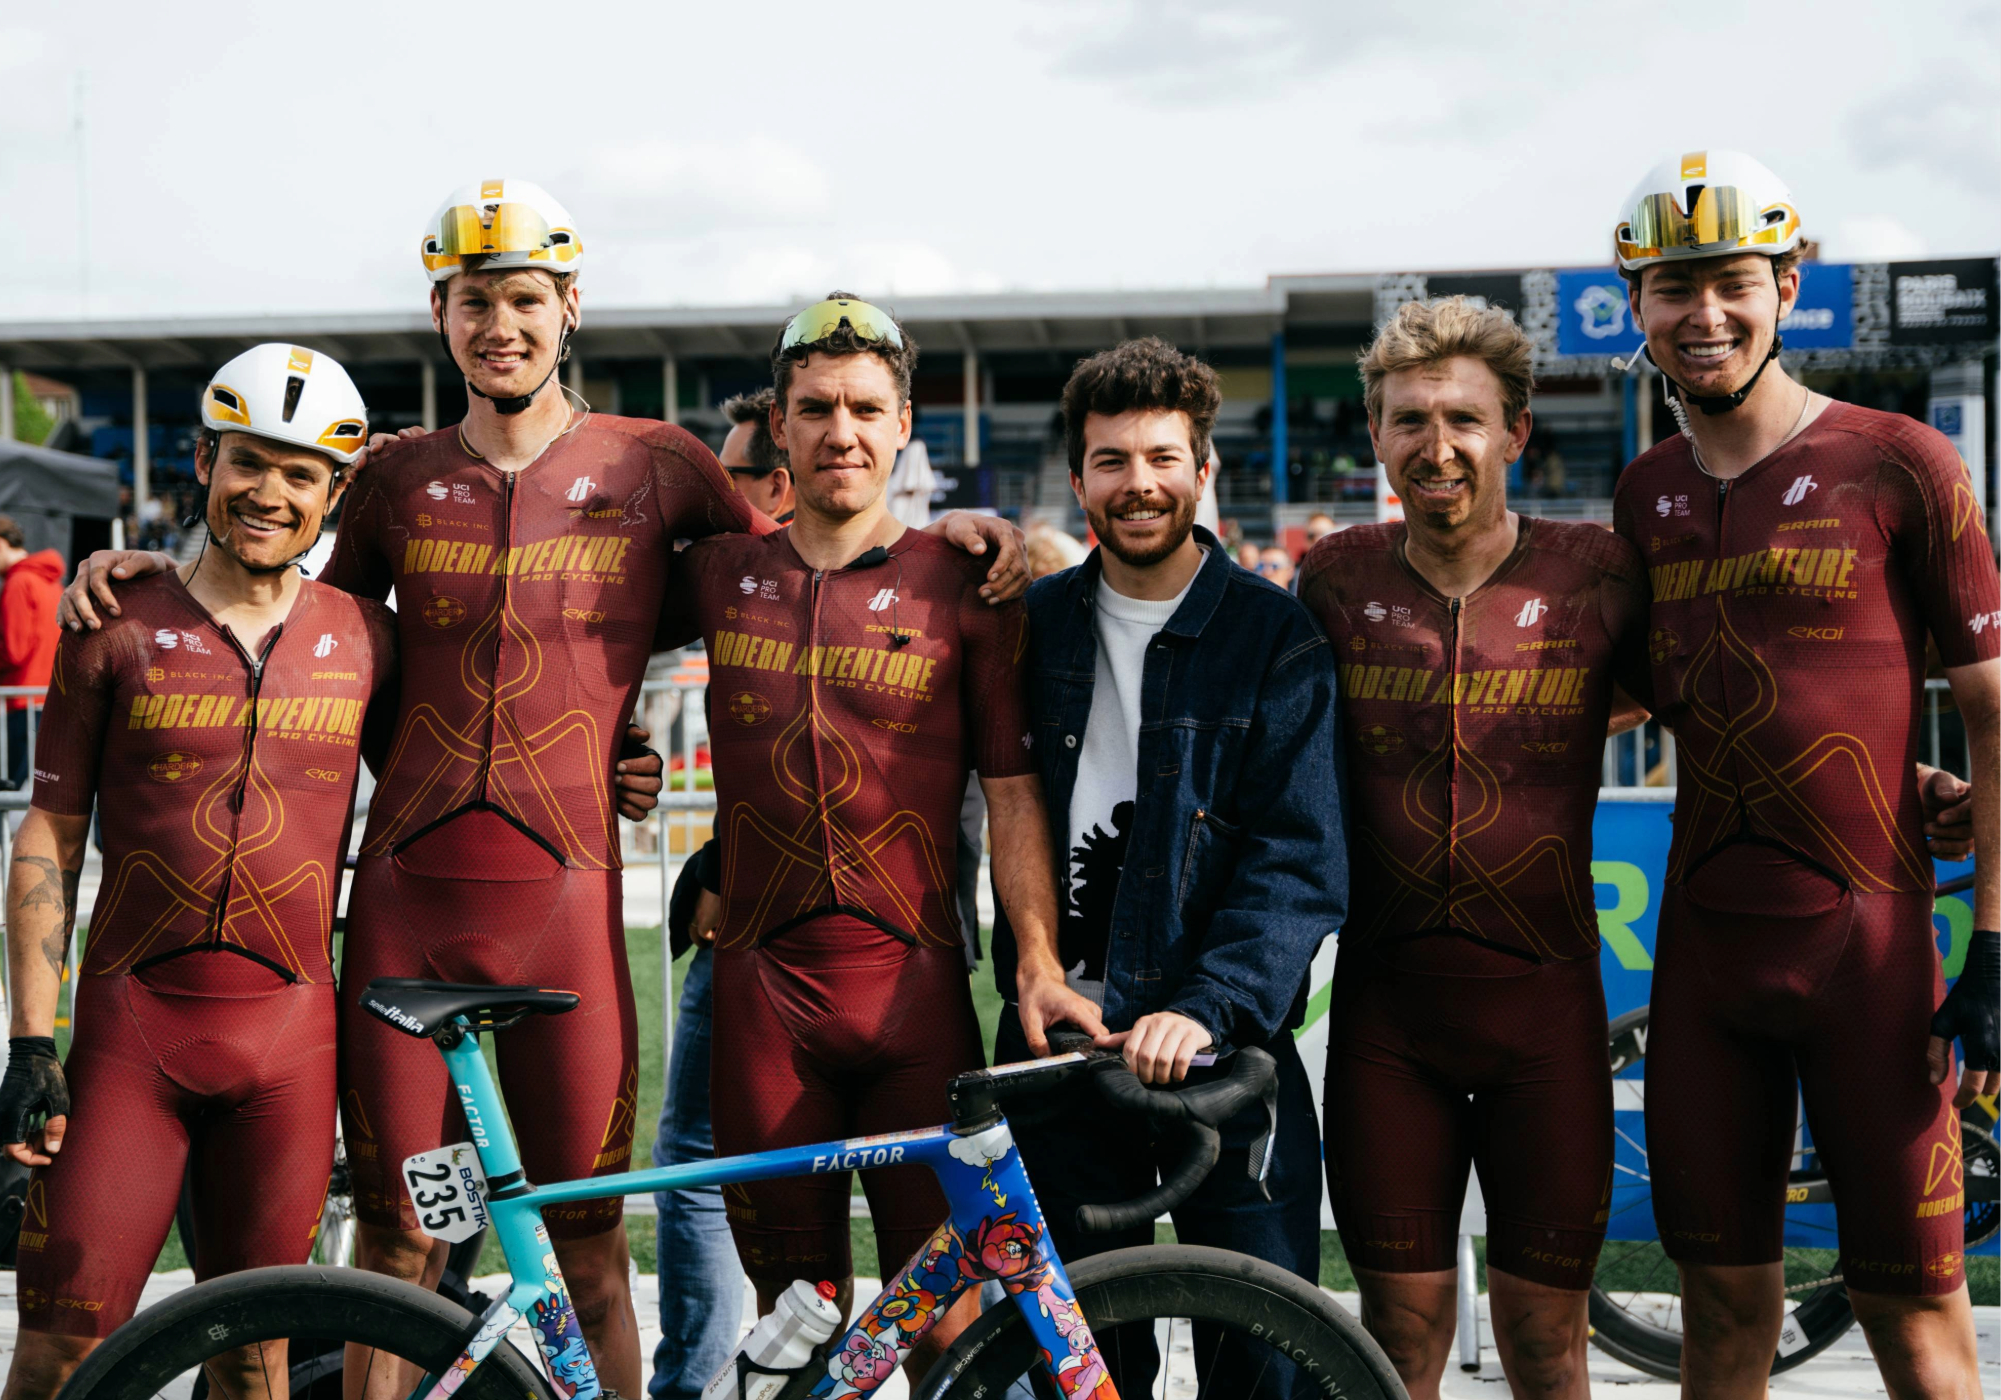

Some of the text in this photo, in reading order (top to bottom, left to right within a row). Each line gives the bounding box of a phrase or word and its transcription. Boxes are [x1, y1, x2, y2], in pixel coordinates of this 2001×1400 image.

[453, 483, 470, 491] UCI
[453, 490, 470, 498] PRO
[453, 496, 475, 505] TEAM
[1674, 495, 1688, 503] UCI
[1674, 502, 1688, 510] PRO
[1674, 509, 1691, 517] TEAM
[437, 518, 490, 531] BLACK INC
[1776, 518, 1840, 532] SRAM
[404, 535, 632, 576] MODERN ADVENTURE
[1703, 548, 1858, 595] ADVENTURE
[520, 572, 625, 585] PRO CYCLING
[762, 579, 778, 587] UCI
[760, 585, 777, 594] PRO
[1735, 587, 1858, 599] PRO CYCLING
[759, 591, 780, 602] TEAM
[1391, 605, 1411, 615] UCI
[740, 612, 790, 628] BLACK INC
[1391, 612, 1411, 623] PRO
[864, 624, 922, 638] SRAM
[1391, 619, 1416, 630] TEAM
[181, 630, 201, 642] UCI
[183, 637, 203, 647] PRO
[185, 644, 212, 656] TEAM
[1370, 642, 1404, 651] BLACK
[1514, 639, 1577, 652] SRAM
[793, 645, 937, 692] ADVENTURE
[170, 671, 233, 682] BLACK INC
[311, 671, 357, 681] SRAM
[825, 678, 933, 703] PRO CYCLING
[1430, 667, 1590, 706] ADVENTURE
[127, 694, 363, 737] MODERN ADVENTURE
[1469, 705, 1585, 716] PRO CYCLING
[266, 731, 356, 747] PRO CYCLING
[34, 768, 60, 782] HELIN
[367, 998, 425, 1034] selle italia
[985, 1075, 1035, 1090] BLACK INC
[457, 1084, 490, 1148] FACTOR
[812, 1146, 905, 1173] FACTOR
[407, 1163, 466, 1230] 235
[458, 1166, 490, 1230] BOSTIK
[1916, 1194, 1957, 1218] MODERN
[540, 1208, 588, 1221] ACTOR
[1521, 1246, 1582, 1268] FACTOR
[1850, 1257, 1916, 1275] FACTOR
[1249, 1322, 1320, 1373] BLACK
[955, 1341, 985, 1373] POWER
